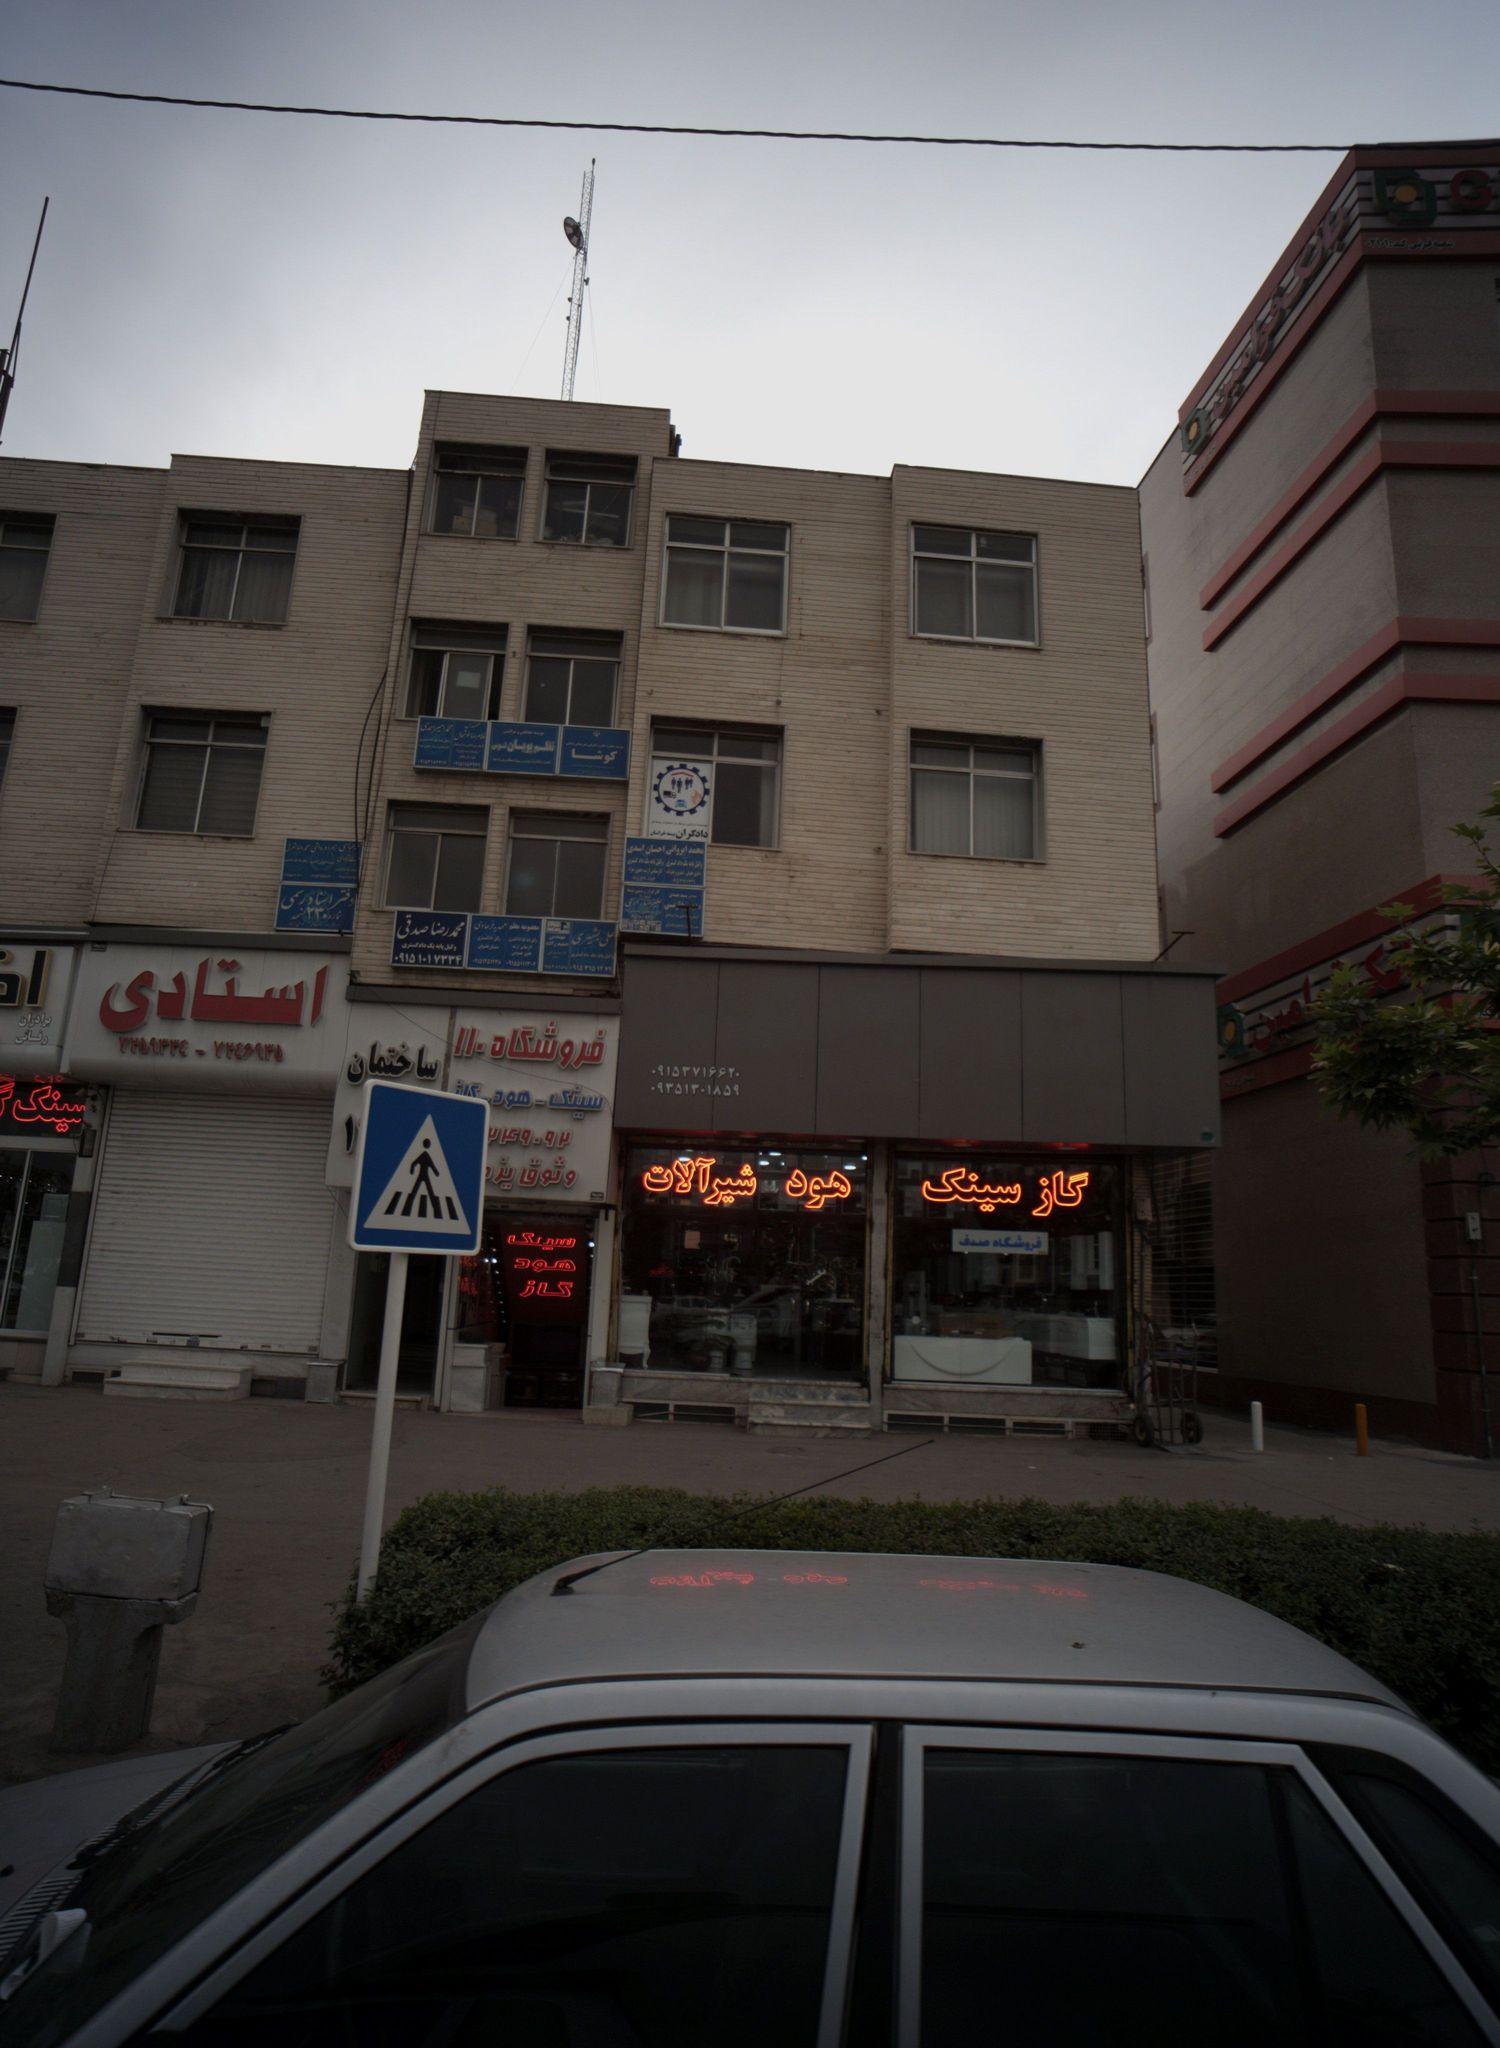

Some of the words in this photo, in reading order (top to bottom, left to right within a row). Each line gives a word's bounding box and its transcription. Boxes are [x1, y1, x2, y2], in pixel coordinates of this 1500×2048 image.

[99, 956, 329, 1033] استادی
[347, 1041, 439, 1085] ساختمان
[454, 1027, 485, 1058] ۱۱۰
[488, 1020, 607, 1069] فروشگاه
[12, 1085, 86, 1134] سینک
[491, 1088, 531, 1111] هود
[548, 1086, 605, 1120] سینک
[519, 1156, 578, 1189] وثوق
[642, 1156, 758, 1206] شیرآلات
[784, 1168, 853, 1210] هود
[921, 1167, 1022, 1213] سینک
[1031, 1170, 1090, 1217] گاز
[993, 1233, 1042, 1251] فروشگاه
[513, 1255, 577, 1274] هود
